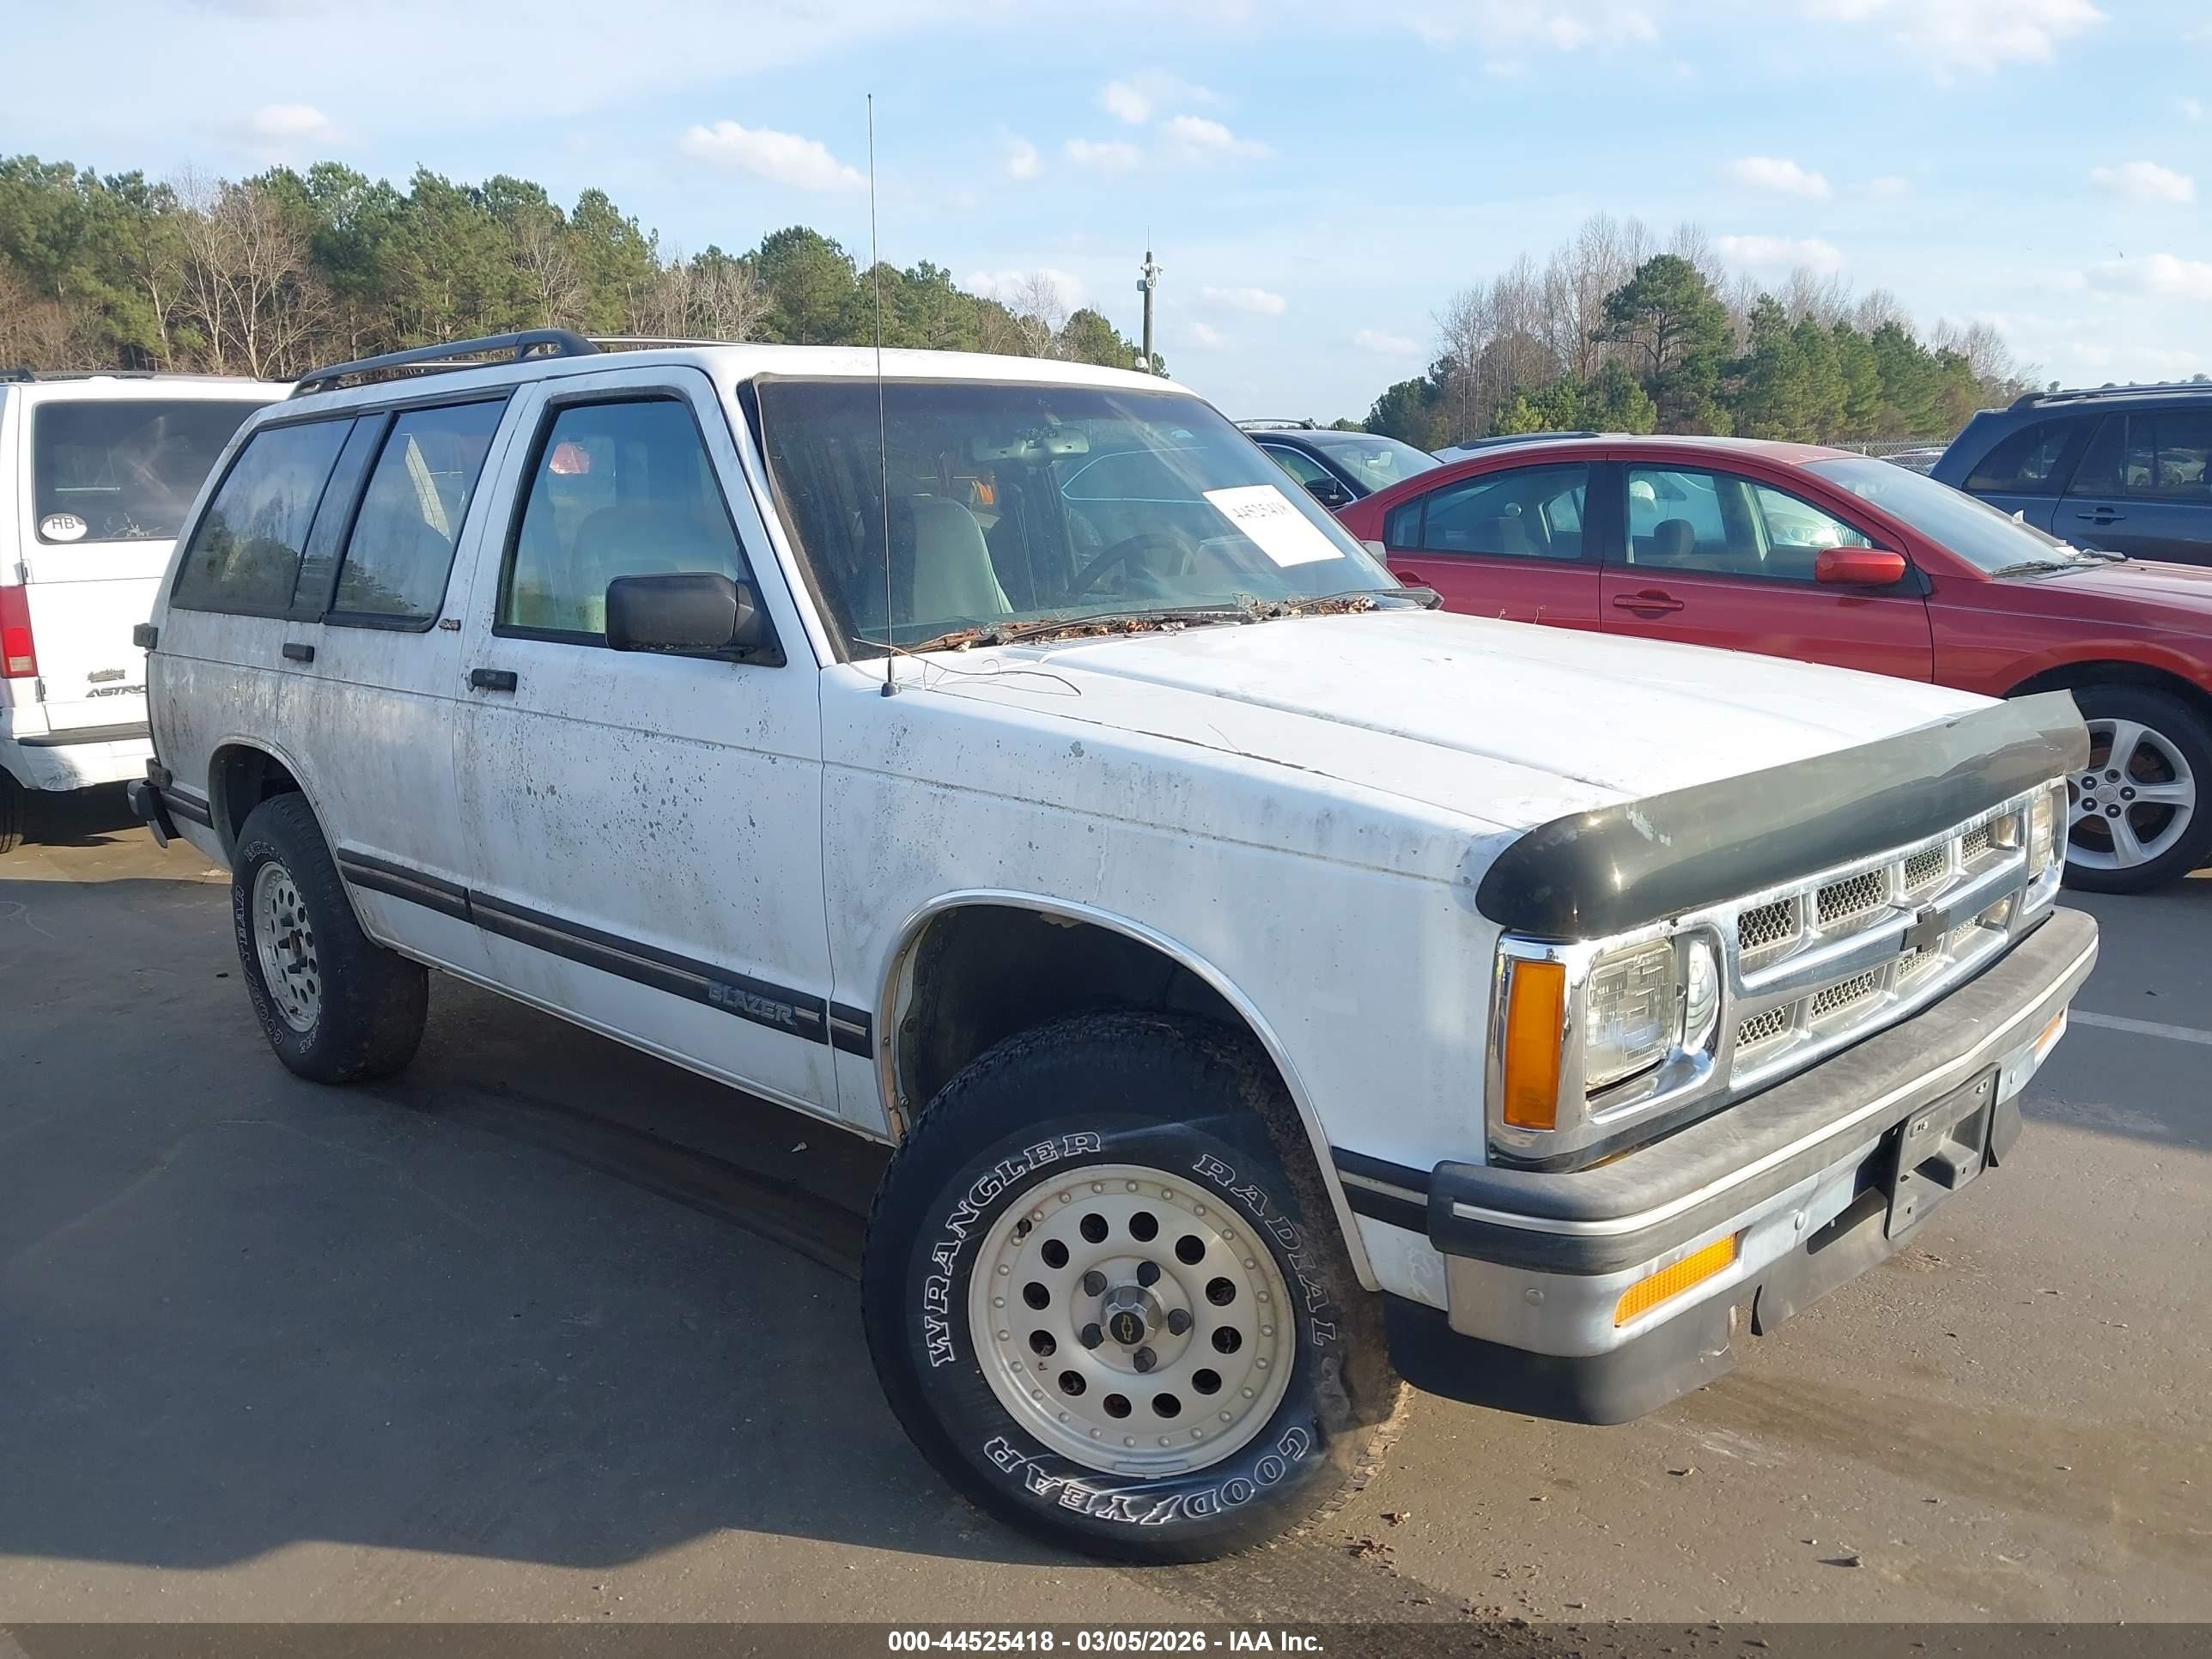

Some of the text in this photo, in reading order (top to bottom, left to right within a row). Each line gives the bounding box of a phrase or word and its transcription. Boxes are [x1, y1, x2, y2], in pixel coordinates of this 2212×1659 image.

[52, 517, 76, 530] HB
[708, 983, 798, 1027] BLAZER
[923, 1131, 1102, 1368] WRANGLER
[1192, 1153, 1336, 1346] RADIAL
